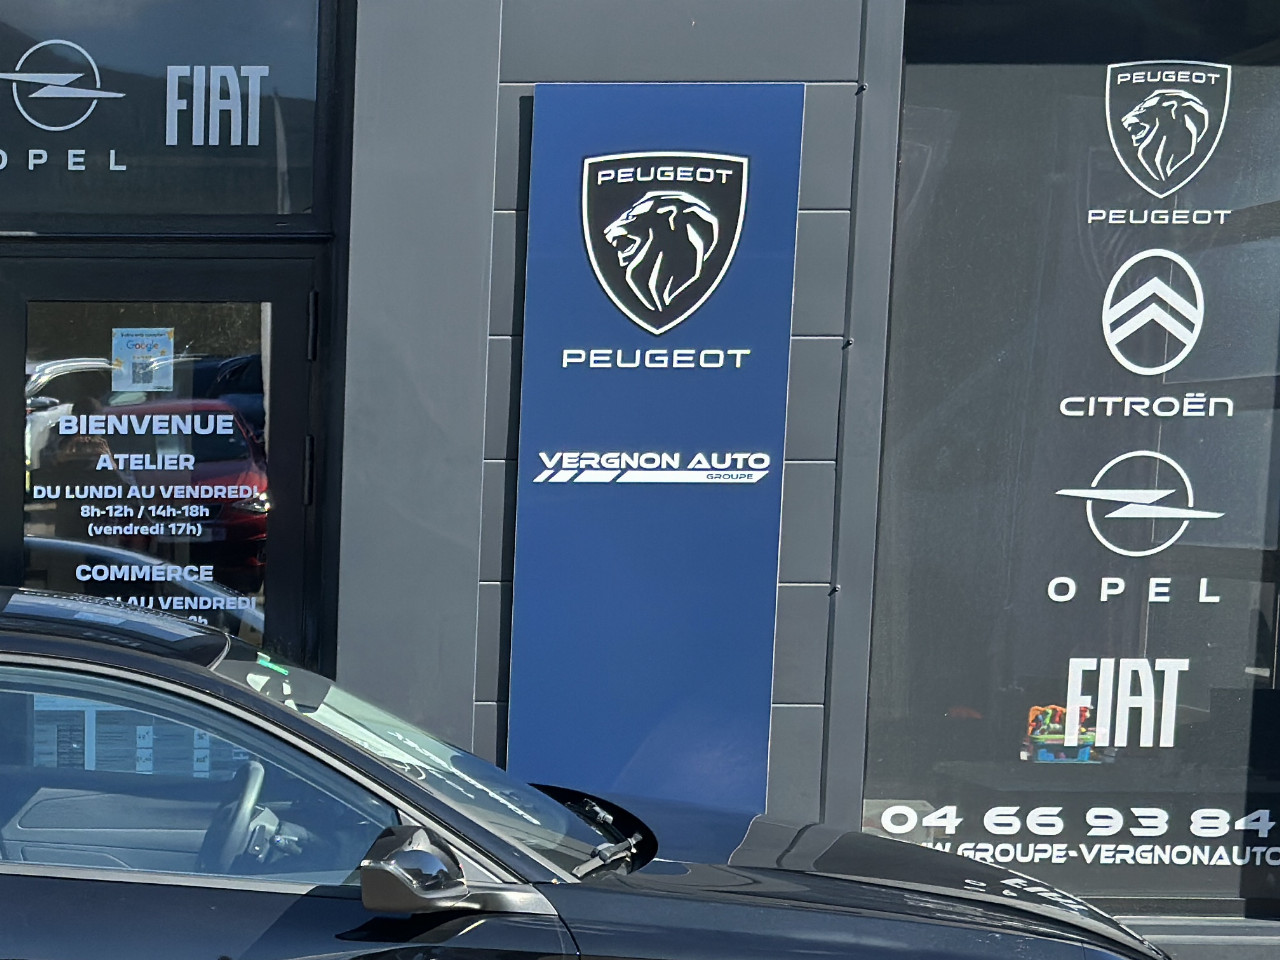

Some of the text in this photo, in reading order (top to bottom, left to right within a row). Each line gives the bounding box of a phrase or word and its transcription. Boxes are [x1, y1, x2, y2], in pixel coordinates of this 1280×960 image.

[1117, 71, 1220, 85] PEUGEOT
[166, 65, 269, 146] FIAT
[598, 166, 733, 185] PEUGEOT
[1088, 210, 1232, 224] PEUGEOT
[126, 340, 159, 351] Google
[562, 349, 751, 368] PEUGEOT
[59, 415, 234, 435] BIENVENUE
[96, 454, 195, 470] ATELIER
[539, 452, 770, 470] VERGNON AUTO
[33, 485, 259, 499] DU LUNDI AU VENDREDI
[81, 505, 210, 519] 8h-12h / 14h-18h
[88, 523, 202, 536] (vendredi 17h)
[75, 565, 214, 581] COMMERCE
[1047, 577, 1220, 603] OPEL
[159, 597, 256, 610] VENDREDI
[1063, 658, 1190, 748] FIAT
[880, 805, 1276, 838] 04 66 93 84
